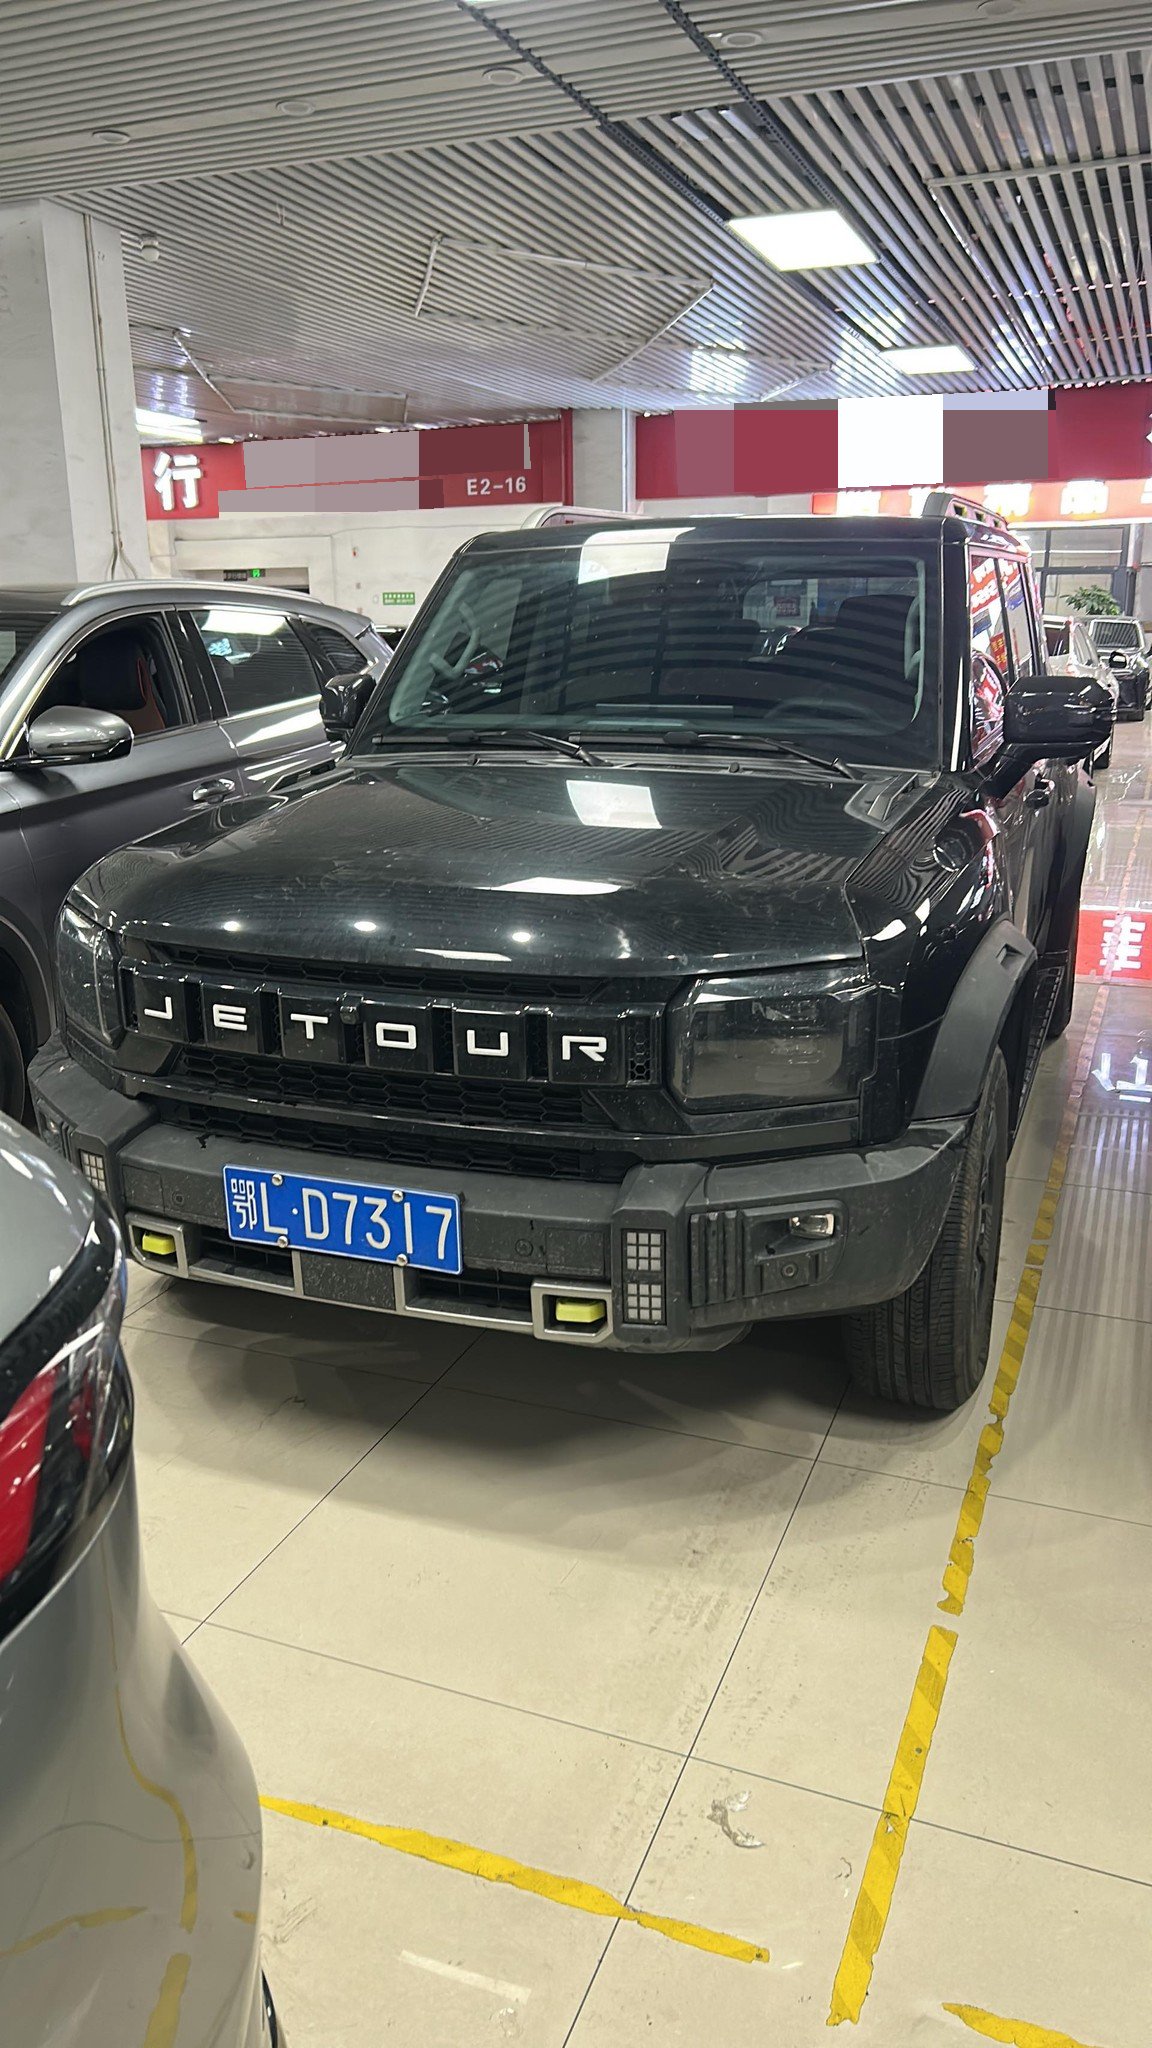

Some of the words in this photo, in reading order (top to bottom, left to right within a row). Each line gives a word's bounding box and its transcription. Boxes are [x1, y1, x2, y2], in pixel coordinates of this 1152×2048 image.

[153, 451, 202, 511] 行
[466, 475, 527, 496] E2-16
[144, 996, 607, 1062] JETOUR
